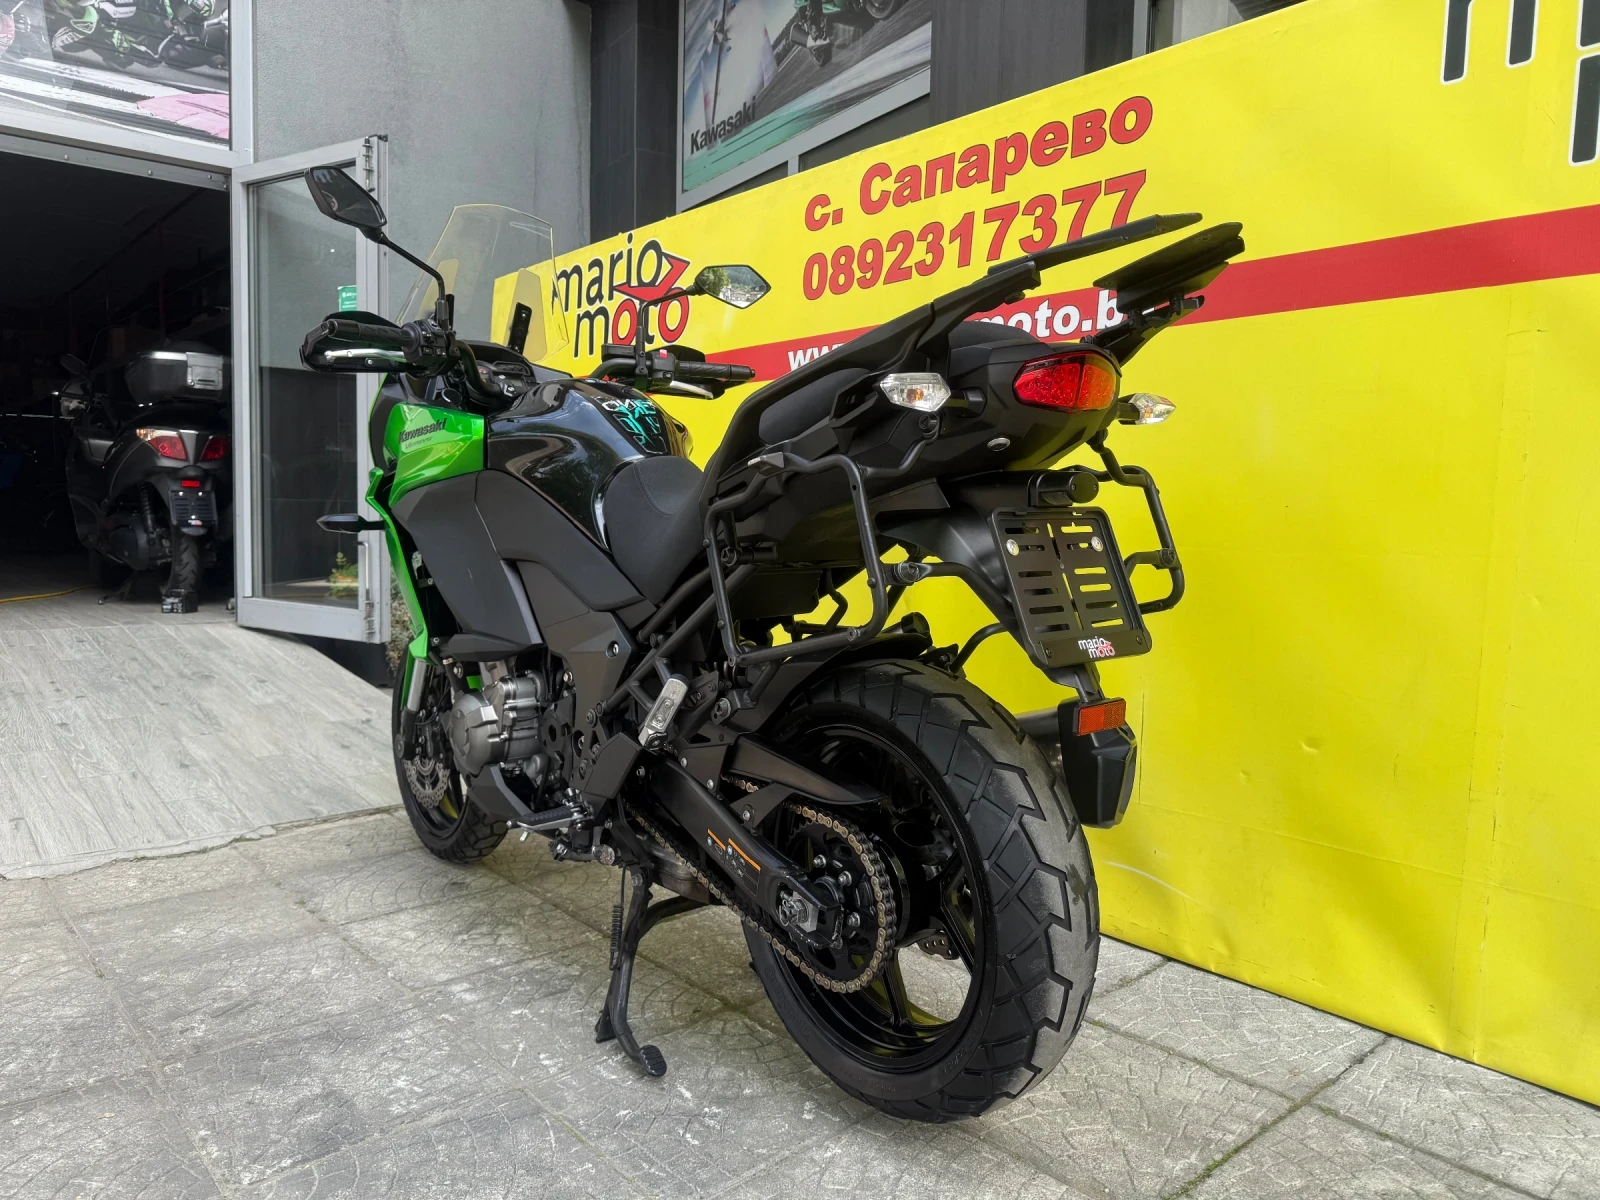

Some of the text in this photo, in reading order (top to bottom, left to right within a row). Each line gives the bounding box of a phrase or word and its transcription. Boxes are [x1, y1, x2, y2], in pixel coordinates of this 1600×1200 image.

[690, 95, 756, 155] Kawasaki
[805, 95, 1154, 232] с. Сапарево
[802, 169, 1147, 301] 0892317377
[552, 232, 663, 315] mario
[574, 287, 690, 358] moto
[398, 417, 447, 443] Kawasaki
[1078, 636, 1106, 650] mario
[1088, 646, 1115, 658] moto
